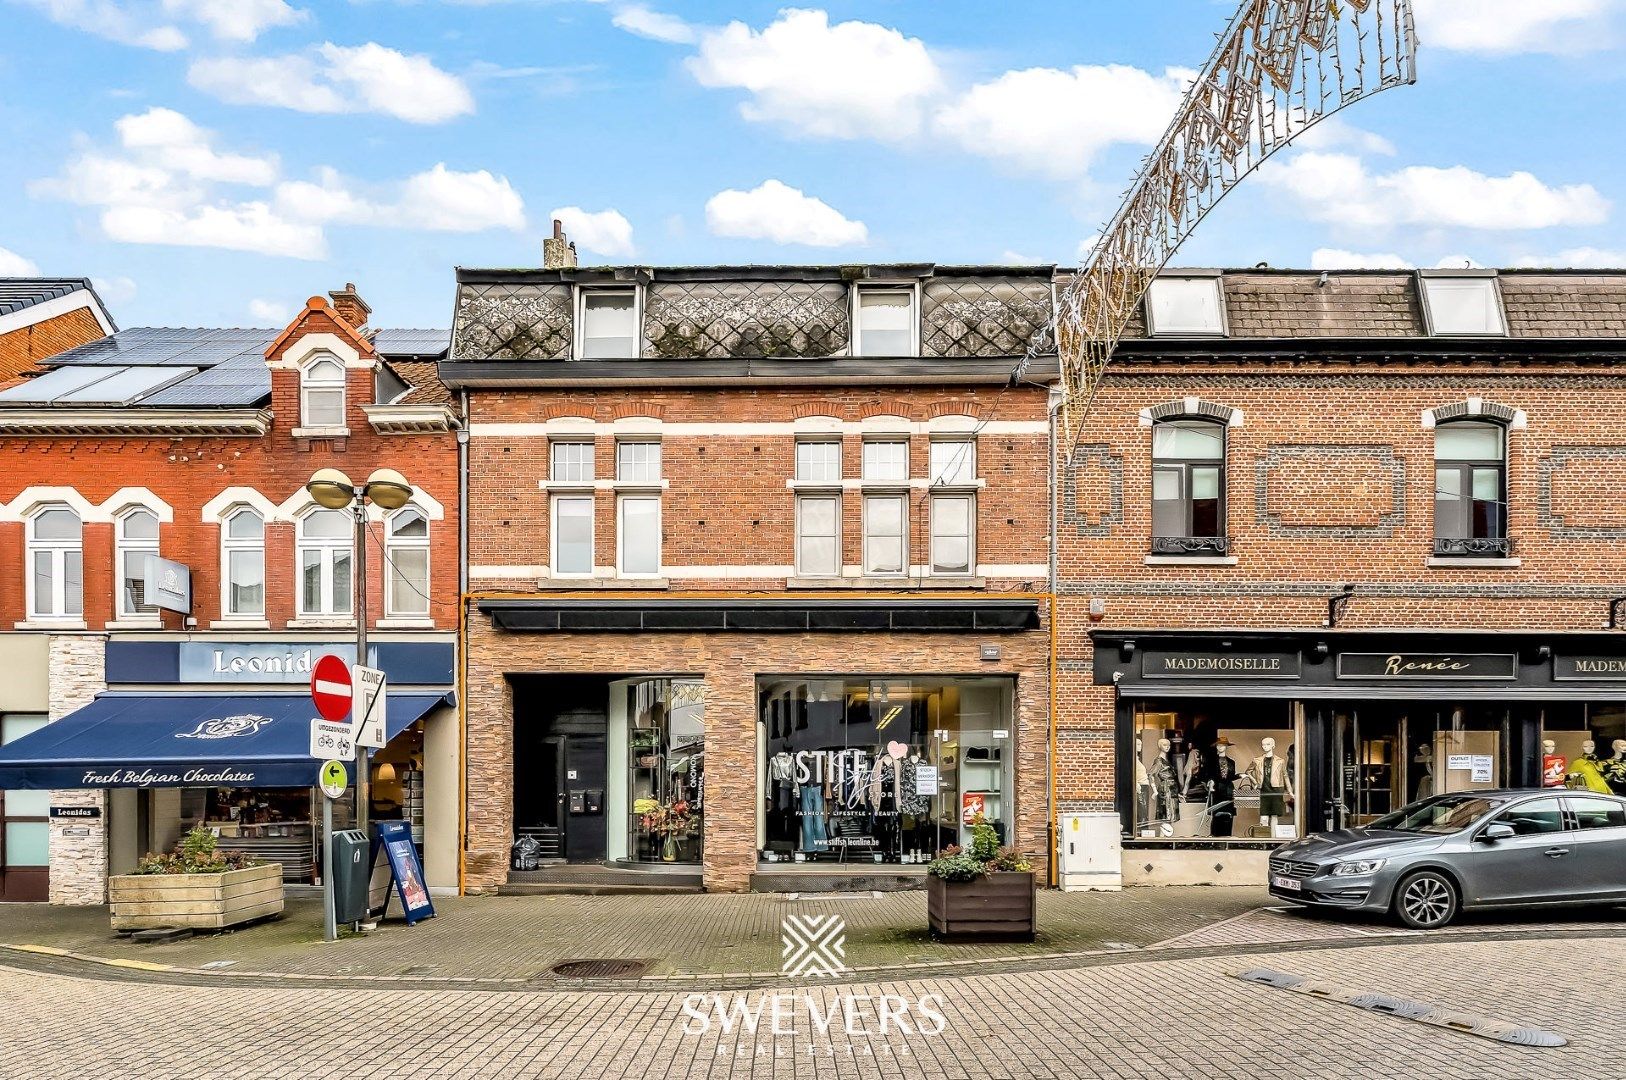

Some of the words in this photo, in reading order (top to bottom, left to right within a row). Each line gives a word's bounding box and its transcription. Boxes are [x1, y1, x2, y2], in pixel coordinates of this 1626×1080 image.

[213, 650, 346, 674] Leonid
[1164, 658, 1280, 670] MADEMOISELLE
[1384, 655, 1470, 675] Renée
[361, 670, 381, 685] ZONE
[82, 769, 122, 784] Fresh
[123, 769, 182, 787] Belgian
[183, 767, 256, 782] Chocolates
